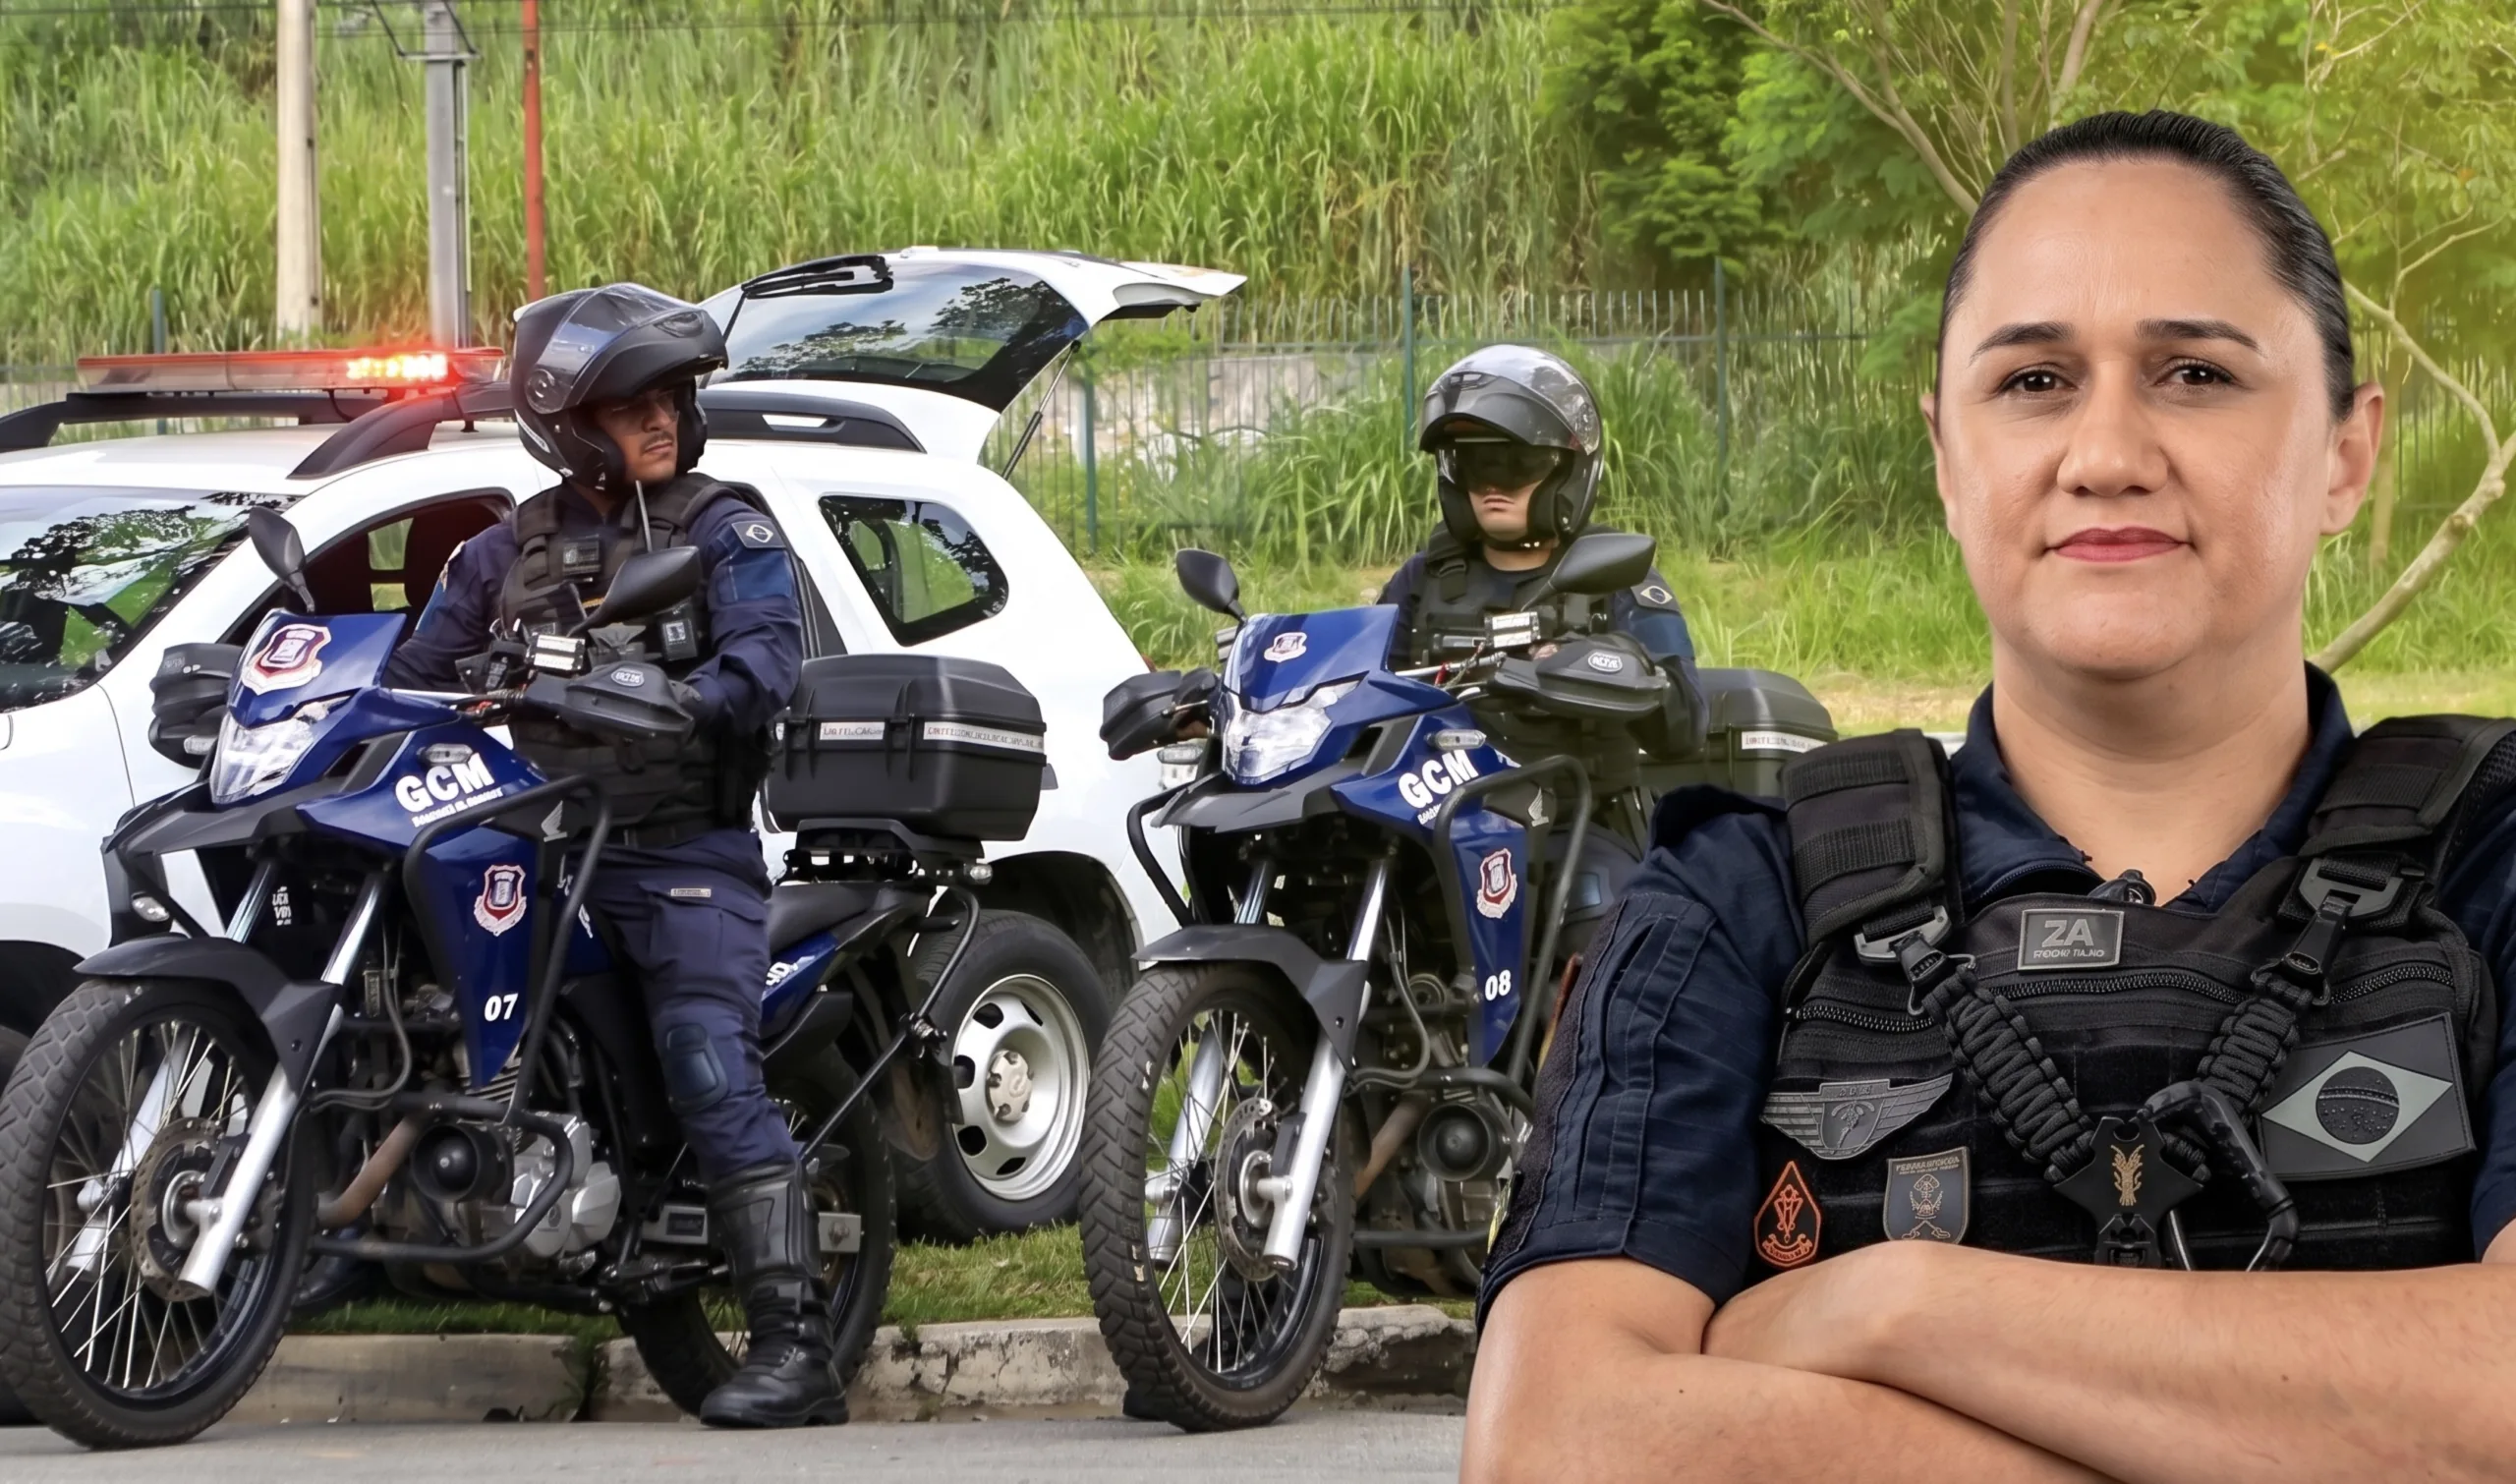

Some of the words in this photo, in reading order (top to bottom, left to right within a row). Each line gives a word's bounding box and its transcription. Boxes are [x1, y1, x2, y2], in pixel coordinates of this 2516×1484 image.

[395, 752, 494, 813] GCM
[1399, 749, 1479, 808] GCM
[2041, 918, 2094, 947] ZA
[1484, 969, 1512, 1000] 08
[484, 993, 519, 1022] 07
